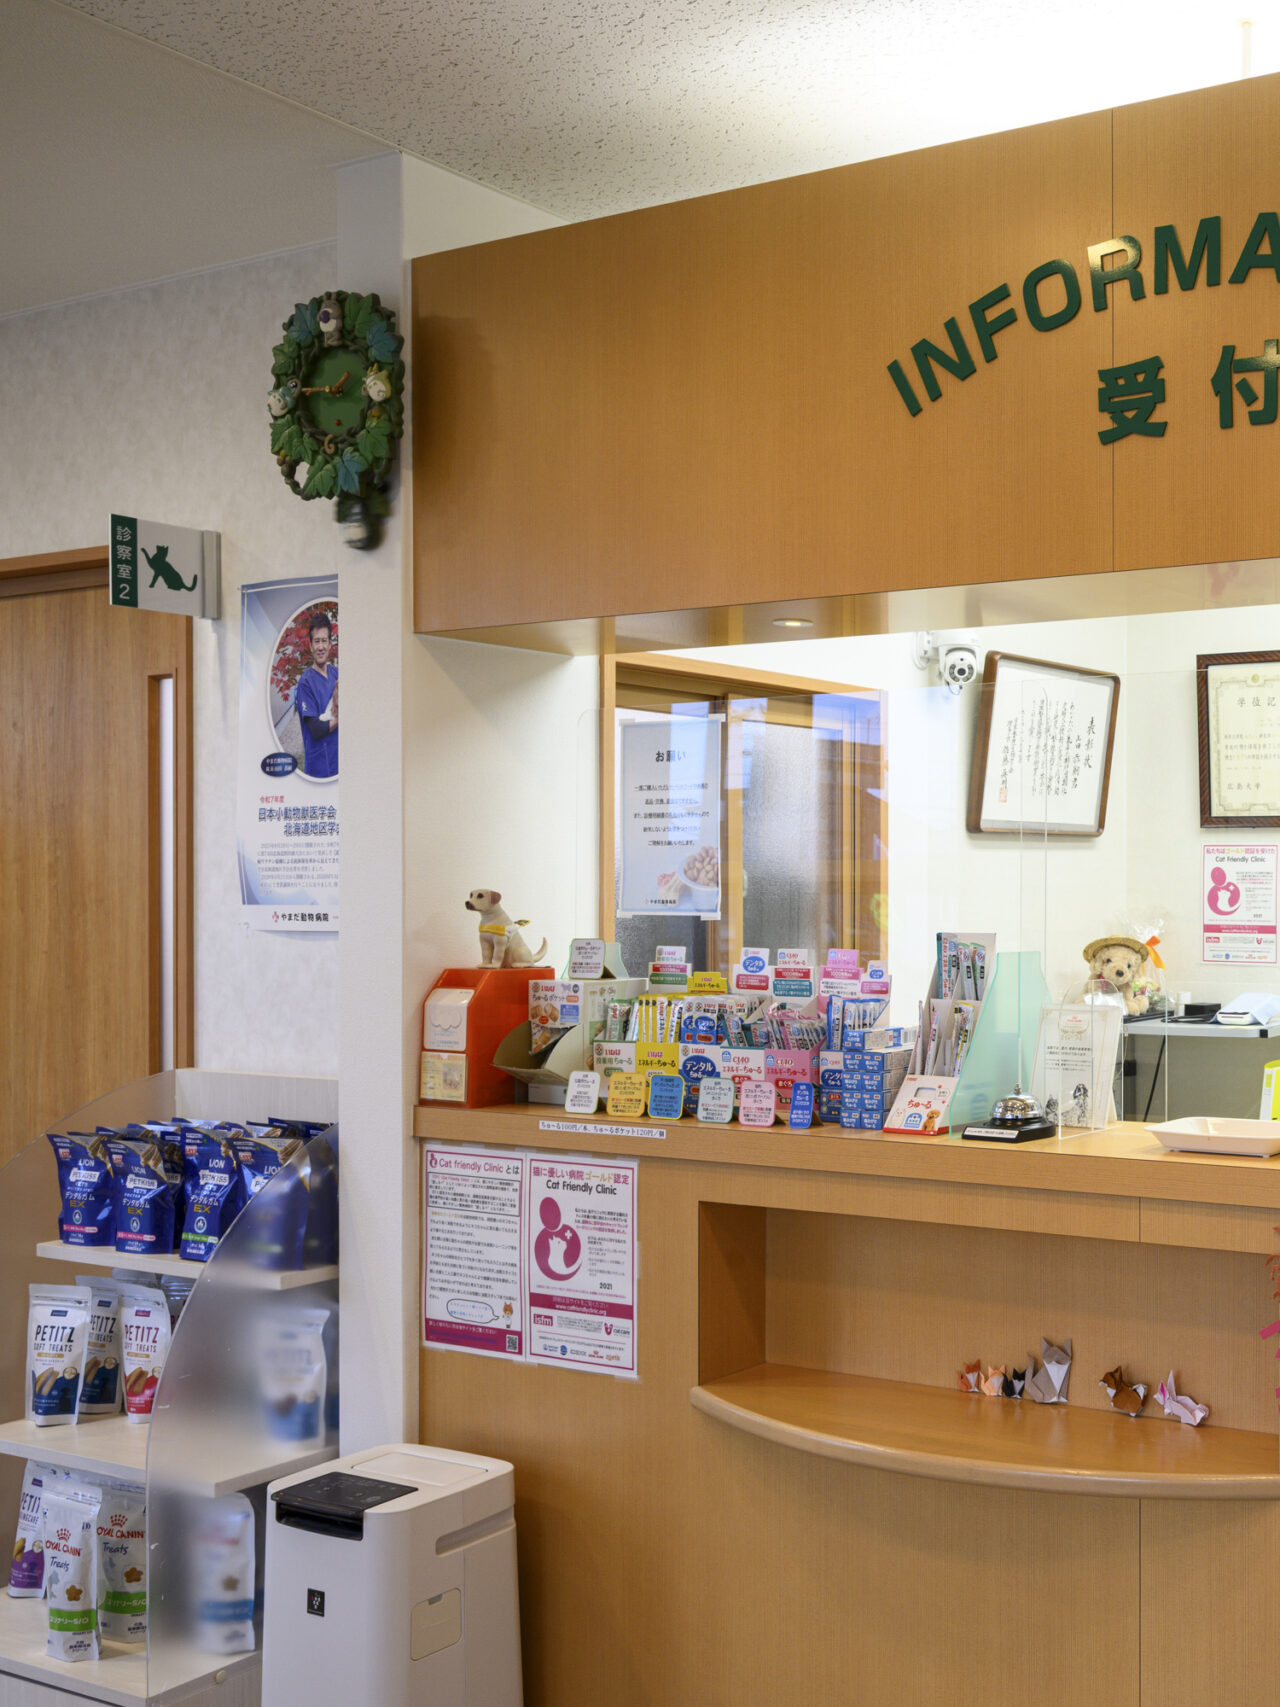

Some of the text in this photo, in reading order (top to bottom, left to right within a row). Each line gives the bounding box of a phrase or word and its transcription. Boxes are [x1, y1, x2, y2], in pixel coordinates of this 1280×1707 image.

[116, 525, 133, 600] 診察室2
[283, 821, 339, 836] 北海道地区学
[686, 1060, 714, 1072] デンタル
[439, 1158, 520, 1175] Cat friendly Clinic とは
[532, 1166, 630, 1185] 猫に優しい病院ゴールド認定
[546, 1180, 617, 1196] Cat Friendly Clinic
[69, 1200, 85, 1208] EX
[127, 1207, 143, 1215] EX
[193, 1204, 211, 1214] EX
[35, 1325, 75, 1343] PETITZ
[124, 1324, 159, 1343] PETITZ
[34, 1342, 73, 1353] SOFT TREATS
[136, 1343, 157, 1353] TREATS
[21, 1491, 41, 1511] PETIT
[96, 1526, 145, 1539] OYAL CANIN
[45, 1540, 82, 1557] OYAL CANIN
[103, 1542, 128, 1555] Treats
[50, 1556, 70, 1571] Treats
